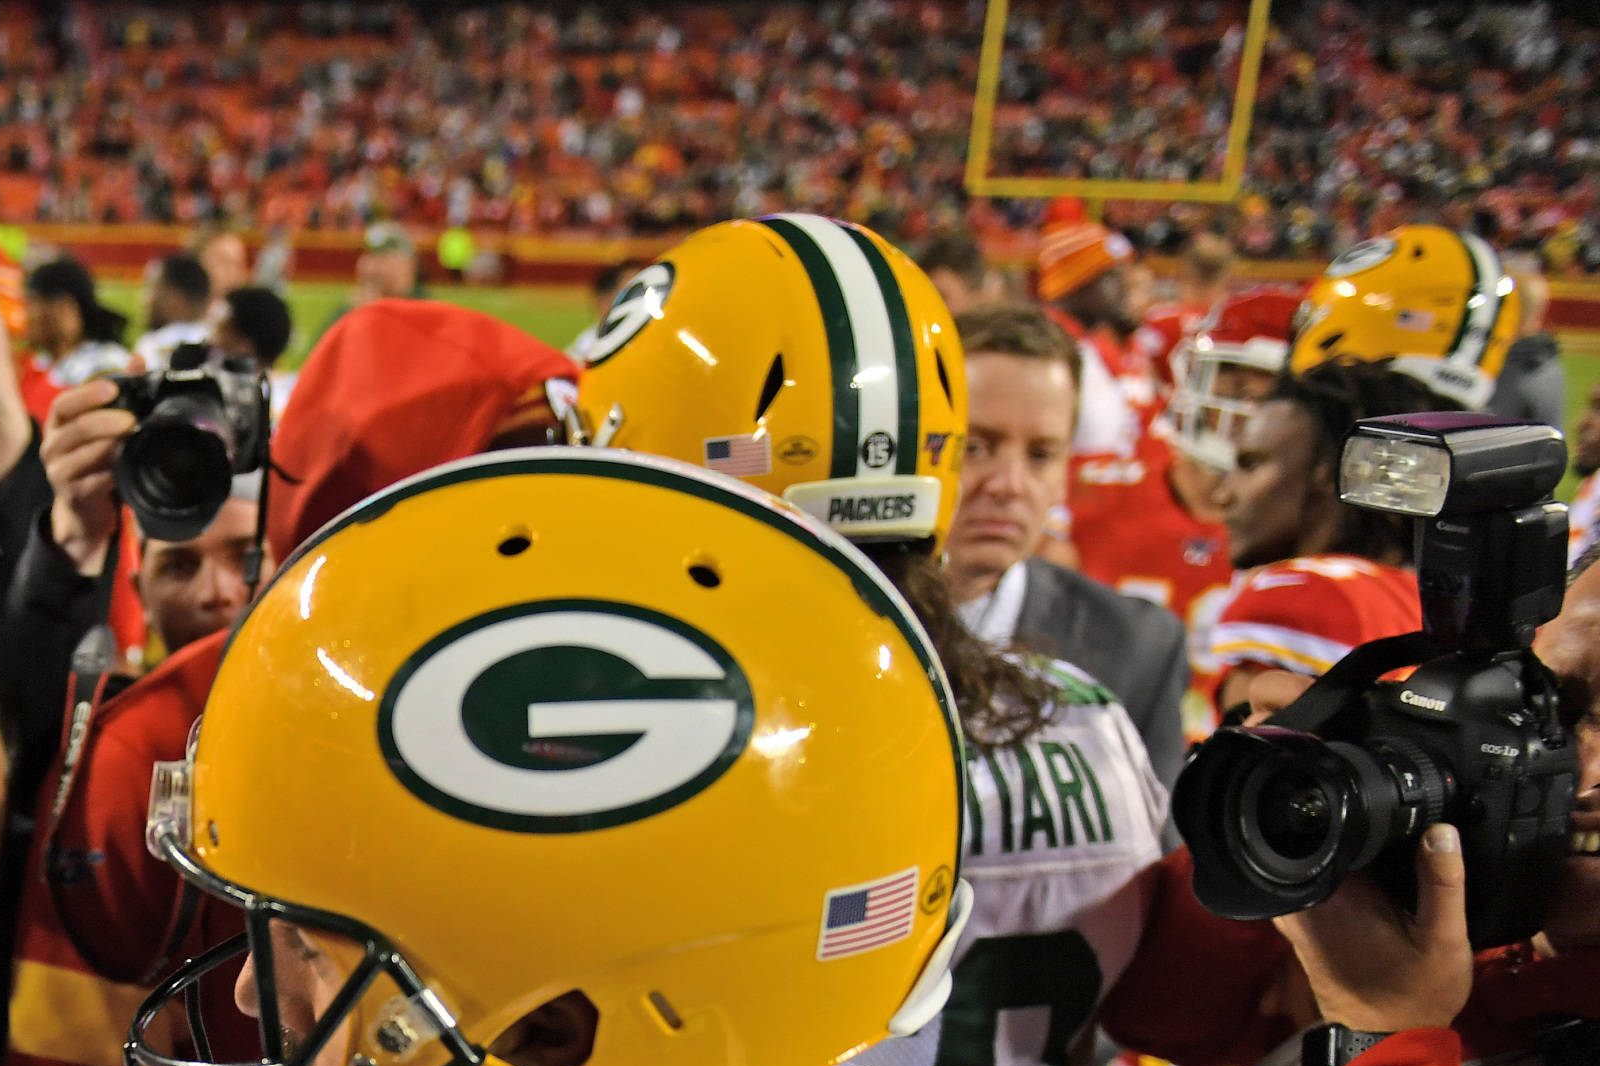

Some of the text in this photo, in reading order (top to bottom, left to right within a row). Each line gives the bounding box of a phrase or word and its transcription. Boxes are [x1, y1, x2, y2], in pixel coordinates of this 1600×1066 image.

[829, 493, 916, 522] PACKERS
[391, 610, 738, 818] G
[1400, 690, 1447, 712] Canon
